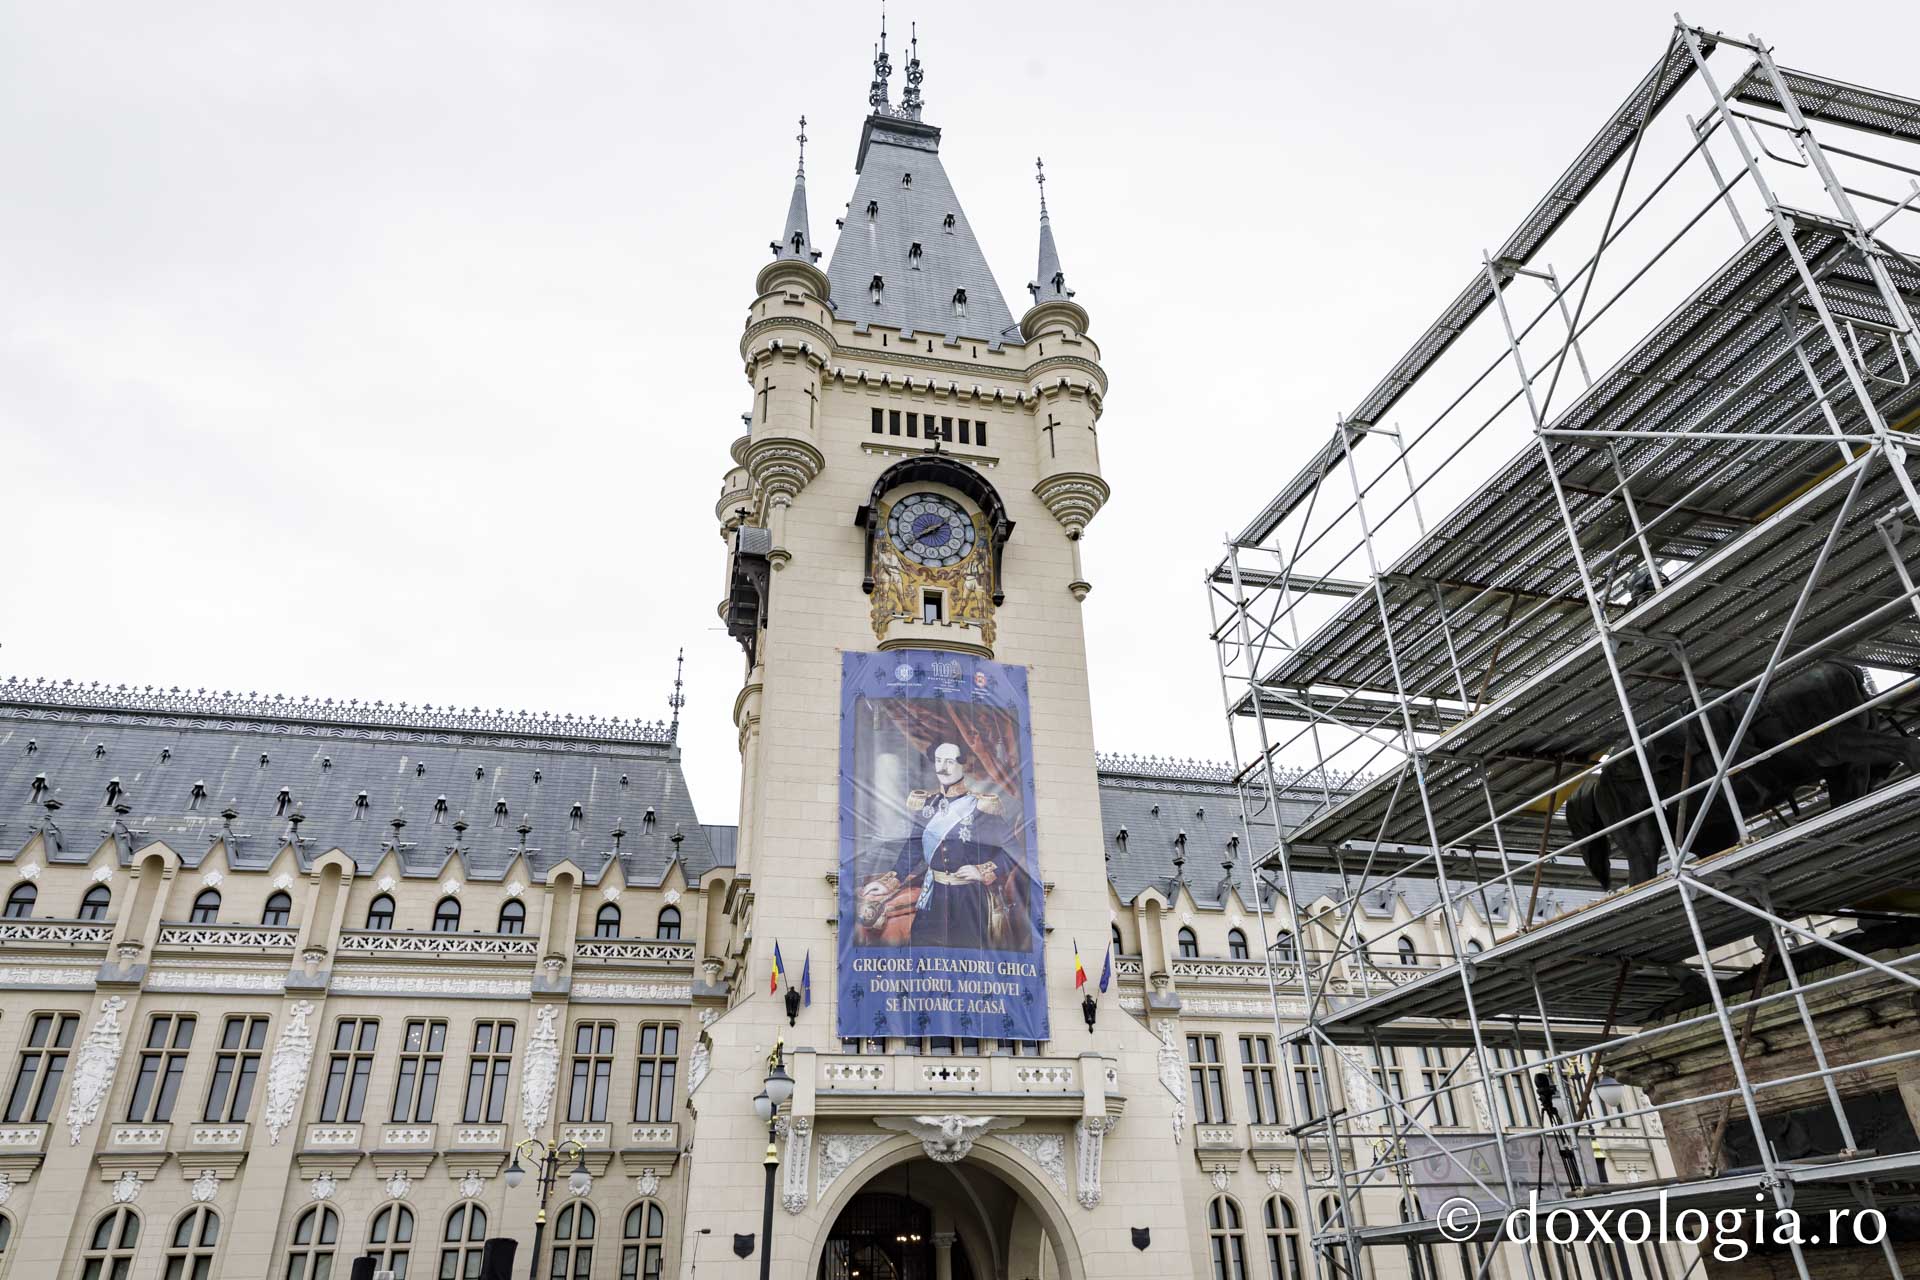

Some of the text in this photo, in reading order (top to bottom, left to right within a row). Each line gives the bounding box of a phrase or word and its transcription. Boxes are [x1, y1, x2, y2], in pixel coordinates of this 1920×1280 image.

[852, 958, 1037, 977] GRIGORE ALEXANDRU GHICA
[870, 978, 1020, 996] DOMNITORUL MOLDOVEI
[886, 998, 900, 1012] SE
[902, 995, 964, 1012] ÎNTOARCE
